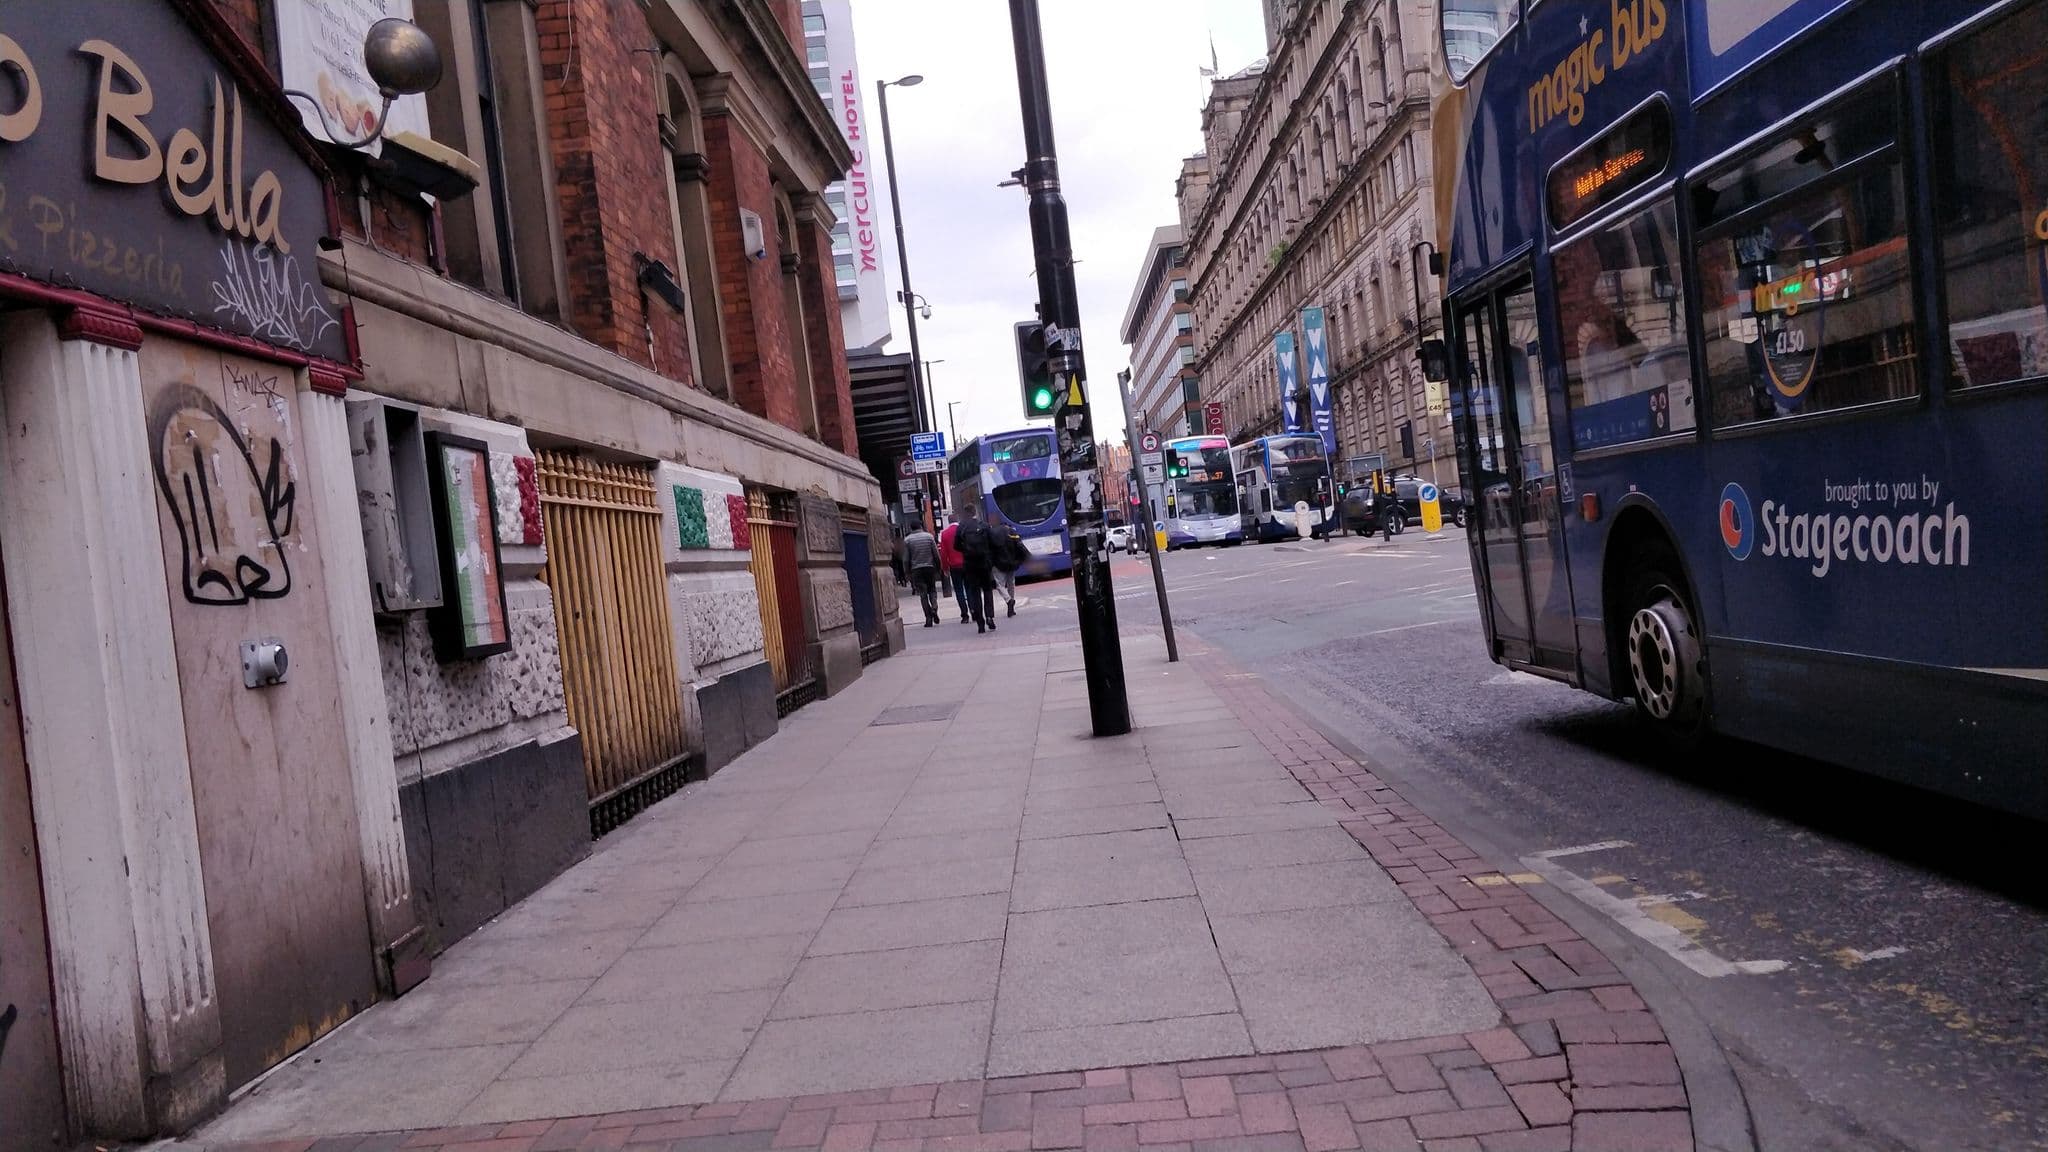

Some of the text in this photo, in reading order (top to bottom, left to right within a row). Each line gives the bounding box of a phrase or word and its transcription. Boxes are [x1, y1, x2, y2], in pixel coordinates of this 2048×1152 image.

[841, 69, 860, 140] HOTEL
[1529, 0, 1666, 134] magic bus
[79, 39, 291, 255] Bella
[29, 194, 187, 299] Pizzeria
[1825, 474, 1939, 509] brought to you by
[1761, 499, 1970, 578] Stagecoach
